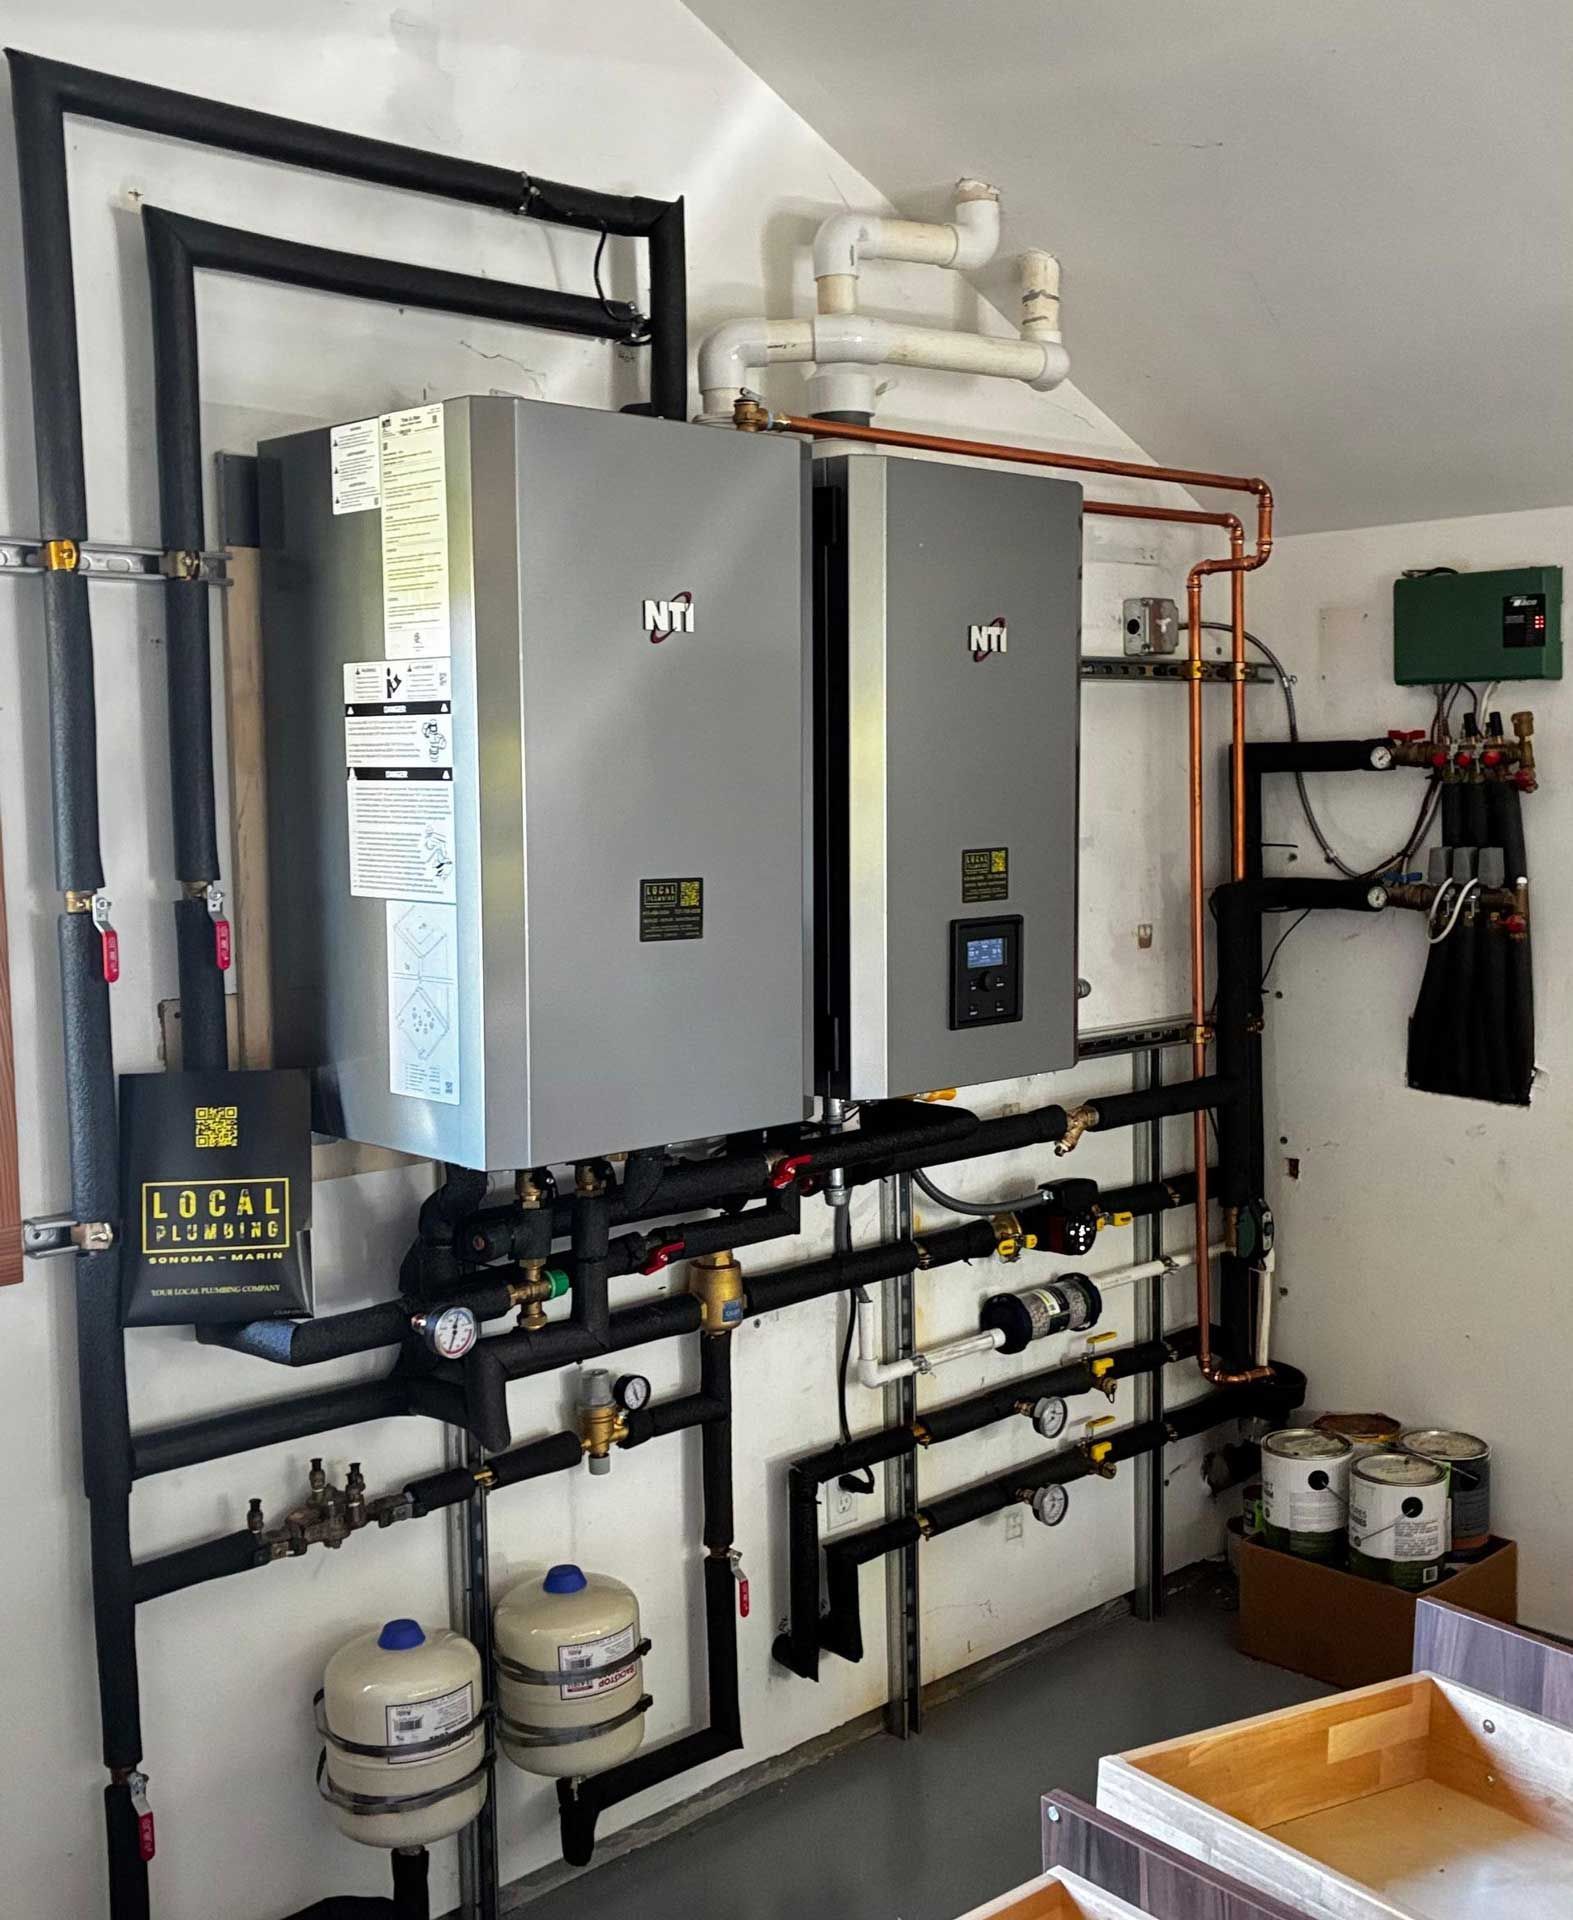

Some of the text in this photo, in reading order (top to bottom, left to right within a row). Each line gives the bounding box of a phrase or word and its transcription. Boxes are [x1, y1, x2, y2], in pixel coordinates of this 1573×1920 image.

[643, 599, 695, 632] NTI
[968, 625, 1008, 653] NTI
[646, 886, 675, 895] LOCAL
[153, 1188, 280, 1219] LOCAL
[155, 1220, 279, 1242] PLUMBING
[148, 1254, 215, 1264] SONOMA
[231, 1252, 283, 1261] MARIN
[151, 1284, 281, 1297] YOUR LOCAL PLUMBING COMPANY
